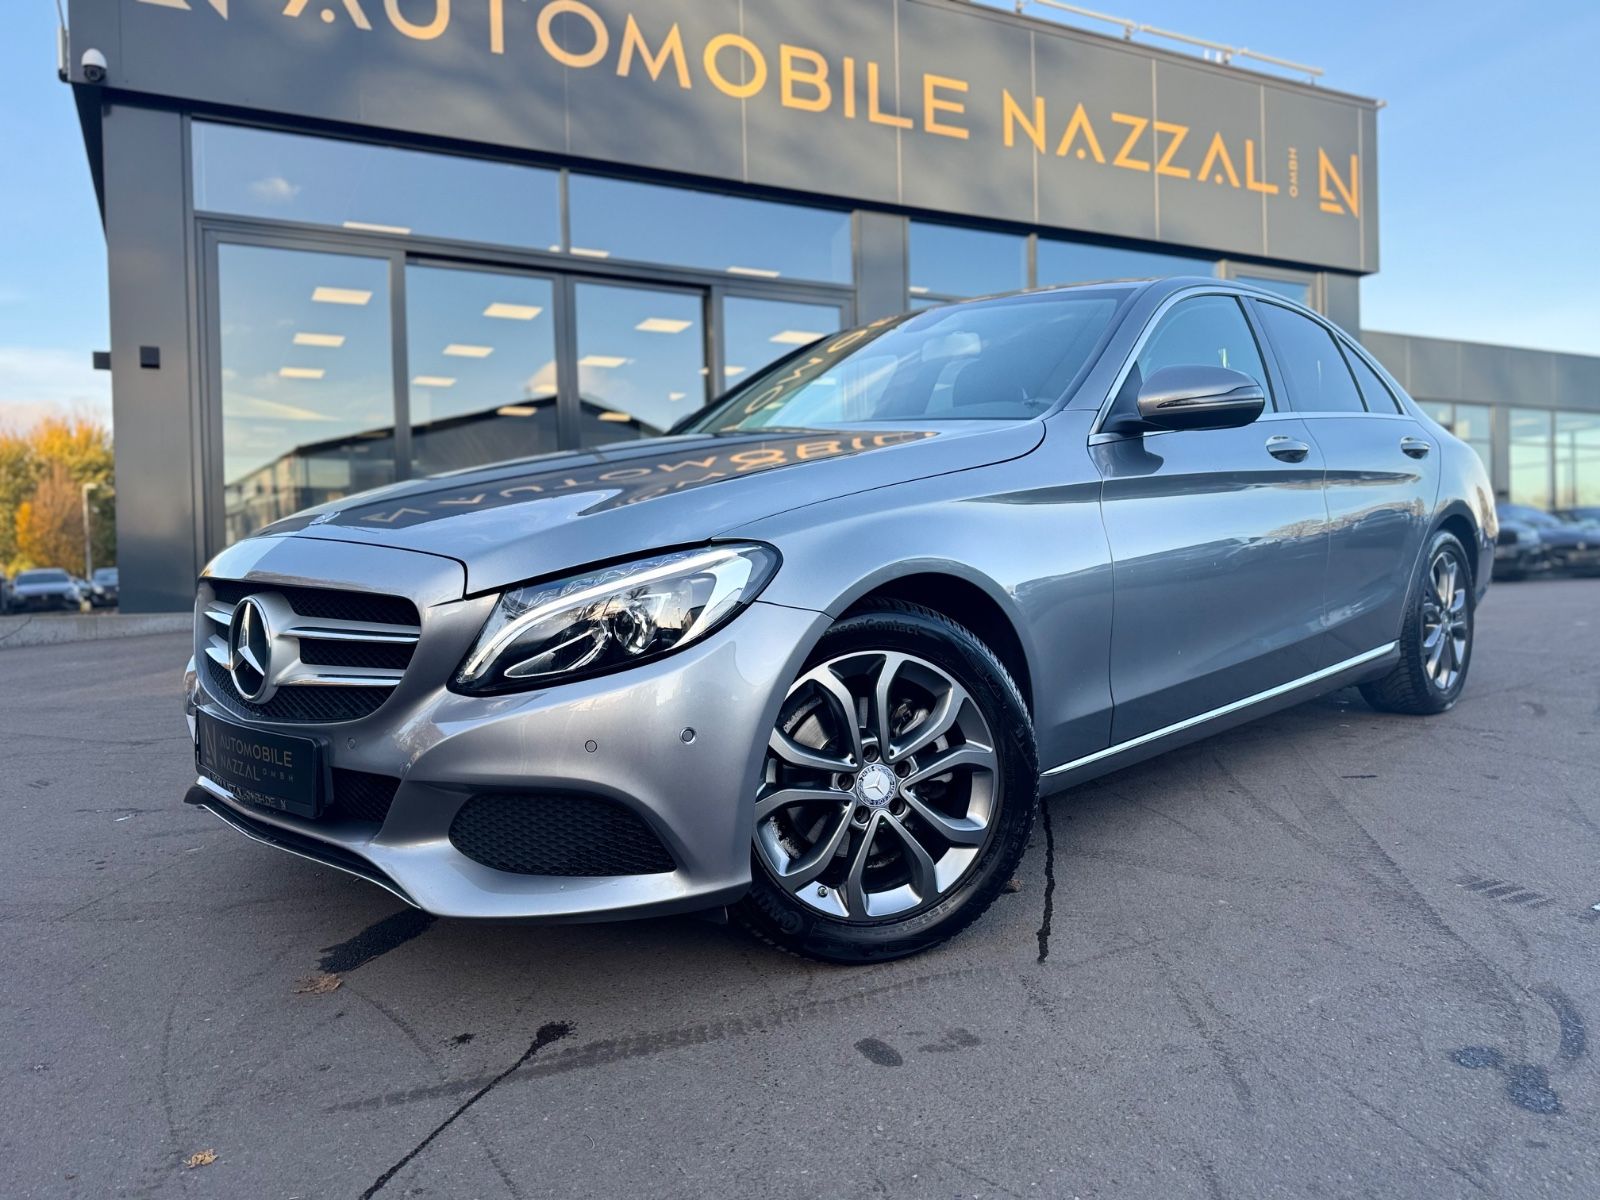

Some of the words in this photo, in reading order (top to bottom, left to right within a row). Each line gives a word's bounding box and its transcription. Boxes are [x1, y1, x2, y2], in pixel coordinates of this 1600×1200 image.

[1003, 89, 1279, 195] NAZZAL
[220, 736, 293, 768] AUTOMOBILE
[220, 754, 261, 782] NAZZAL
